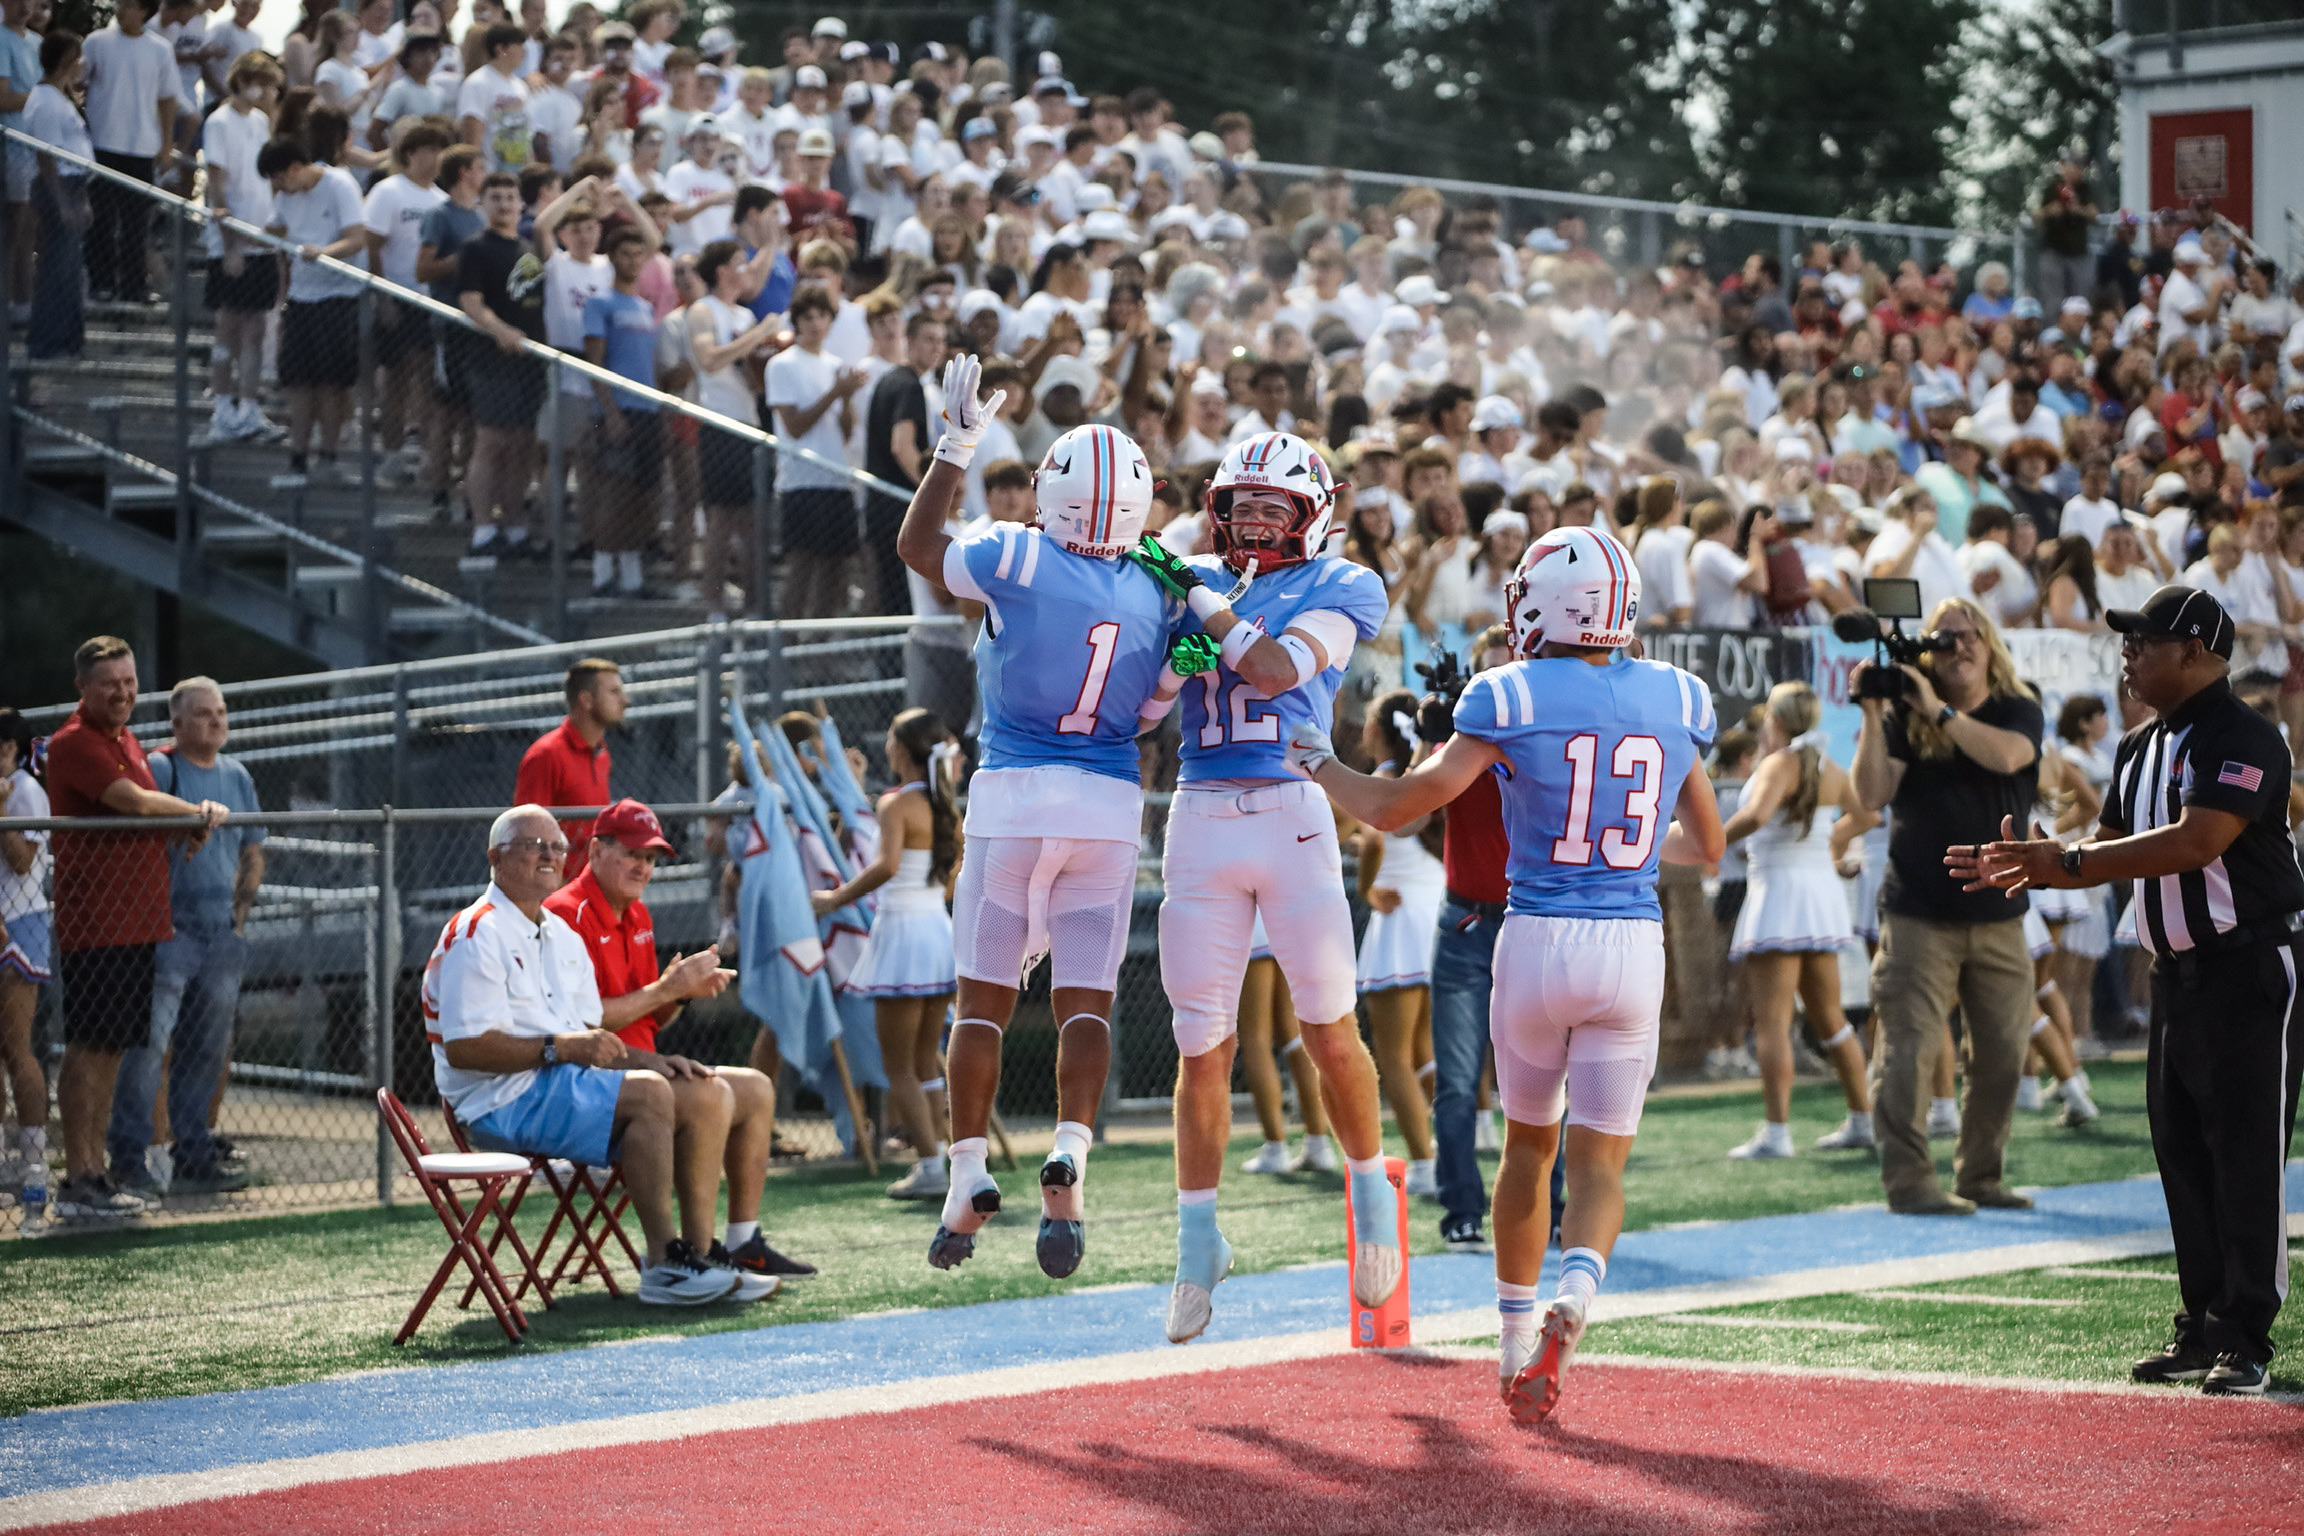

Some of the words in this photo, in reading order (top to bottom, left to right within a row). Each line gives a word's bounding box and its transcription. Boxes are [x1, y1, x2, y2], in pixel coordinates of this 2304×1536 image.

[1234, 474, 1269, 483] Riddell
[1066, 541, 1126, 556] Riddell
[1226, 581, 1247, 602] NXTRND
[1580, 632, 1631, 645] Riddell
[2190, 624, 2200, 635] S
[1057, 621, 1120, 736] 1
[1194, 668, 1280, 750] 12
[1551, 733, 1665, 870] 13
[1358, 1310, 1375, 1342] S
